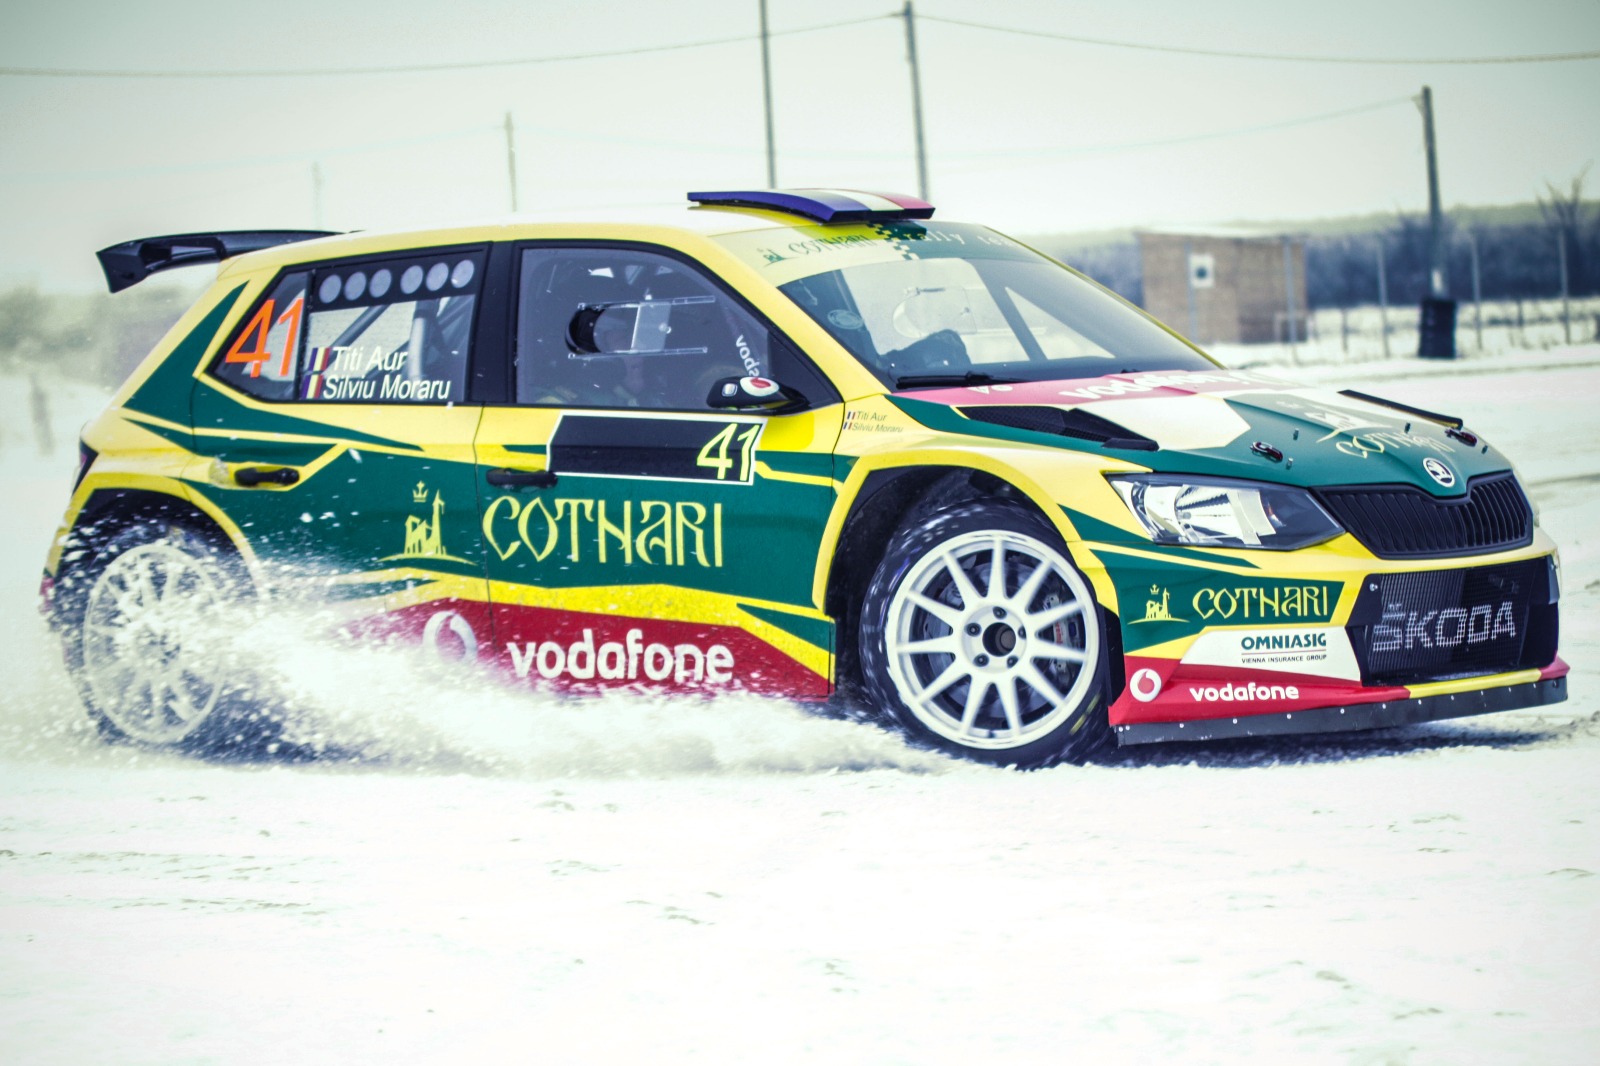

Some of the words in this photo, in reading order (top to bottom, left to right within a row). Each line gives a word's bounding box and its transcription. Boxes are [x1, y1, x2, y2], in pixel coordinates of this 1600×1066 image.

[225, 298, 304, 378] 41
[332, 346, 364, 371] Titi
[365, 346, 409, 371] Aur
[323, 375, 375, 400] Silviu
[379, 374, 451, 400] Moraru
[852, 422, 874, 432] Silviu
[875, 424, 904, 433] Moraru
[857, 411, 869, 421] Titi
[870, 412, 888, 421] Aur
[696, 422, 761, 482] 41
[482, 495, 723, 568] COTNARI
[1192, 586, 1329, 620] COTNARI
[1241, 633, 1327, 650] OMNIASIG
[507, 628, 735, 684] vodafone
[1267, 655, 1304, 663] INSURANCE
[1189, 681, 1300, 702] vodafone
